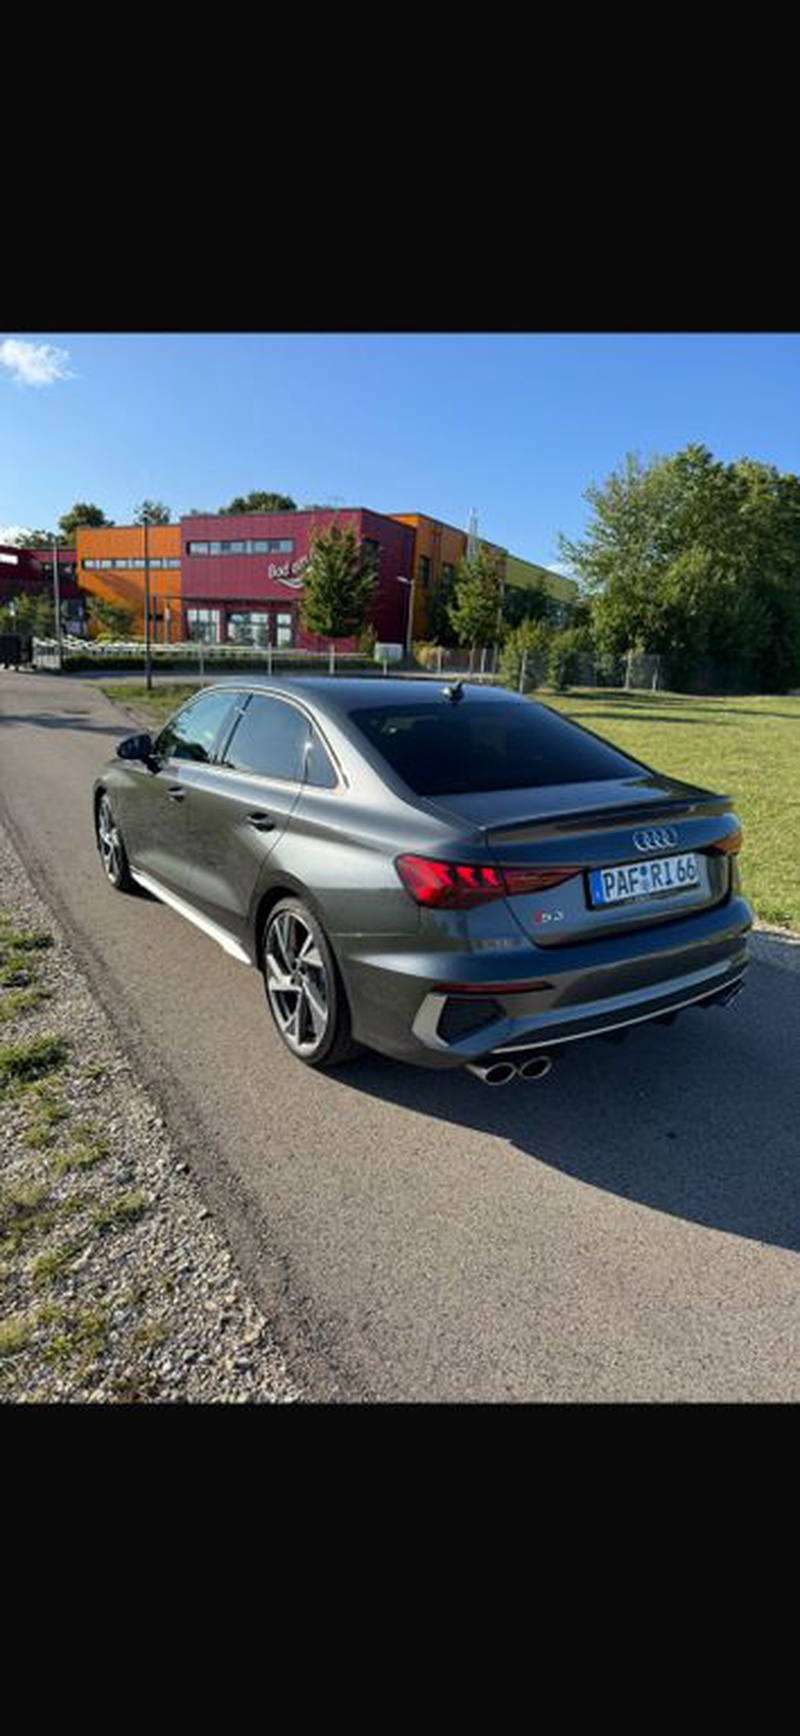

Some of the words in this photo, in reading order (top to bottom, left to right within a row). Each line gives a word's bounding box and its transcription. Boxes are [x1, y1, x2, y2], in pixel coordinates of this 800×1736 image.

[603, 867, 638, 898] PAF
[650, 861, 673, 887] RI
[677, 857, 697, 882] 66
